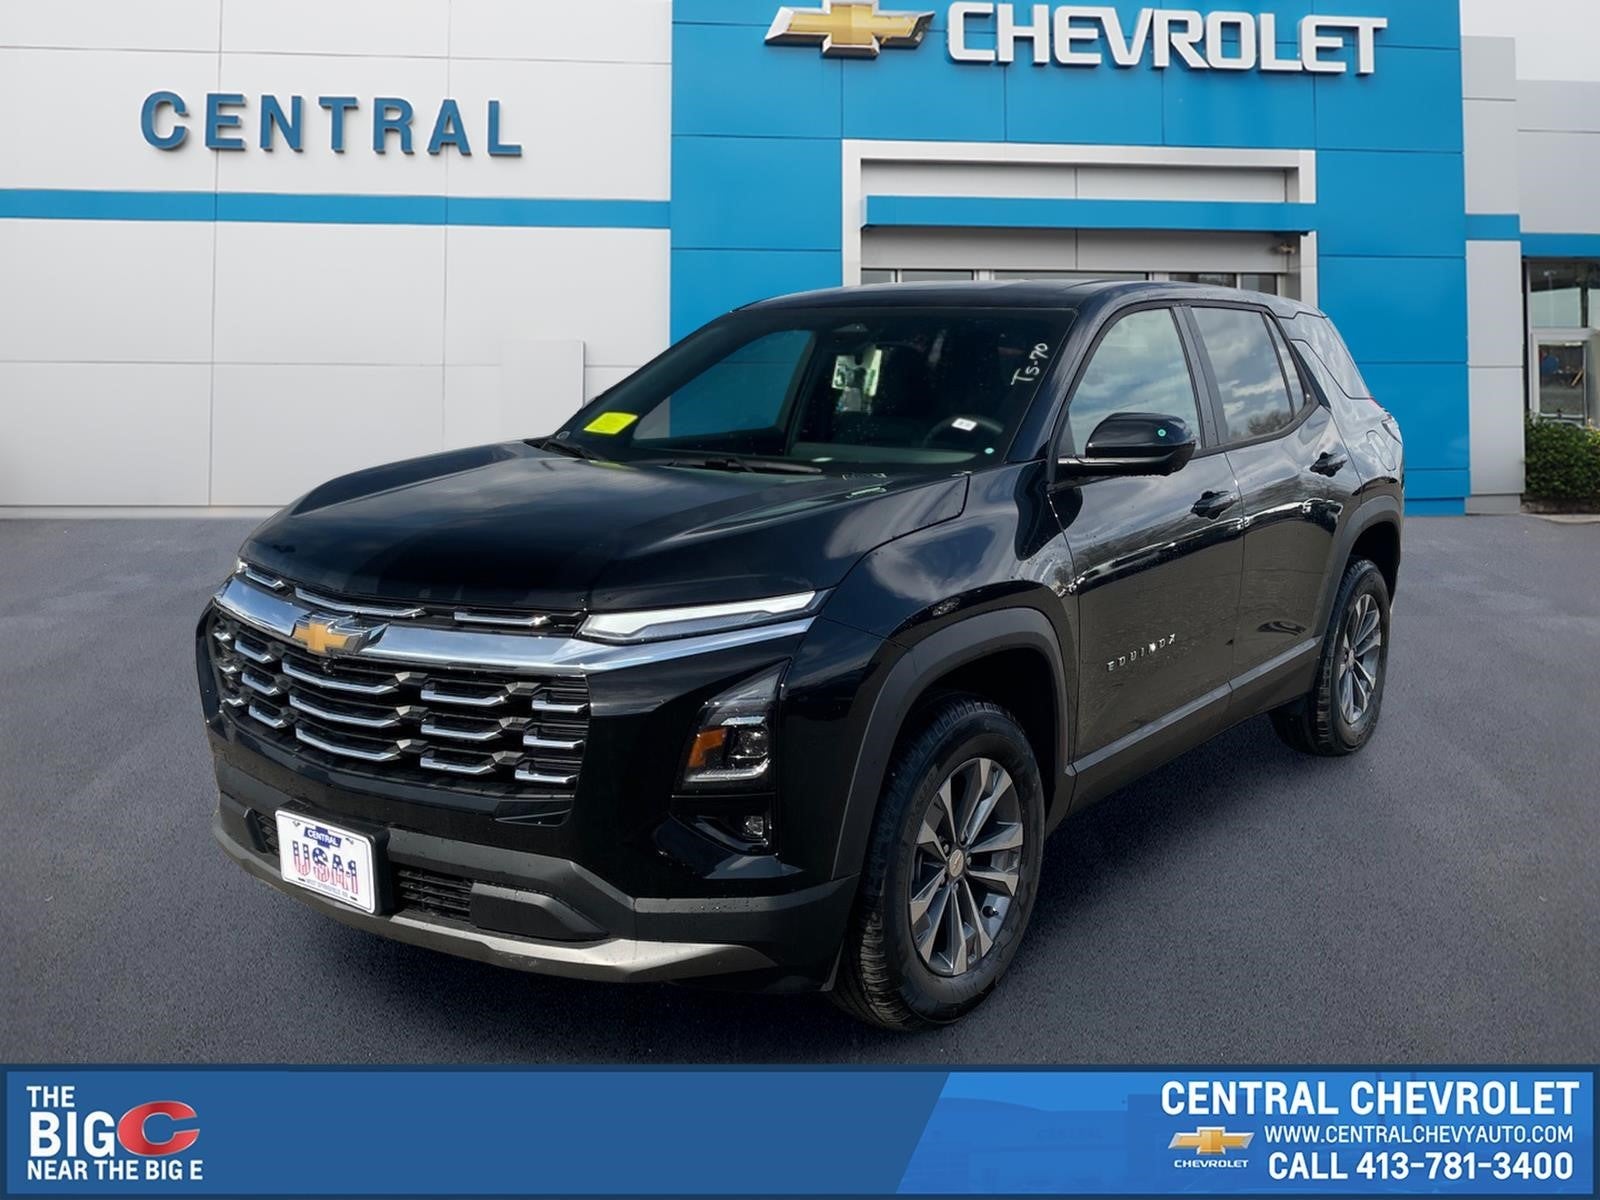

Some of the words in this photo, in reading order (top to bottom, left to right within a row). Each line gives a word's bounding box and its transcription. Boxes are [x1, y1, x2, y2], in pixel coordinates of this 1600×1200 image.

[946, 1, 1389, 76] CHEVROLET
[140, 90, 522, 157] CENTRAL
[1106, 633, 1176, 672] EQUINOX
[307, 828, 340, 847] CENTRAL
